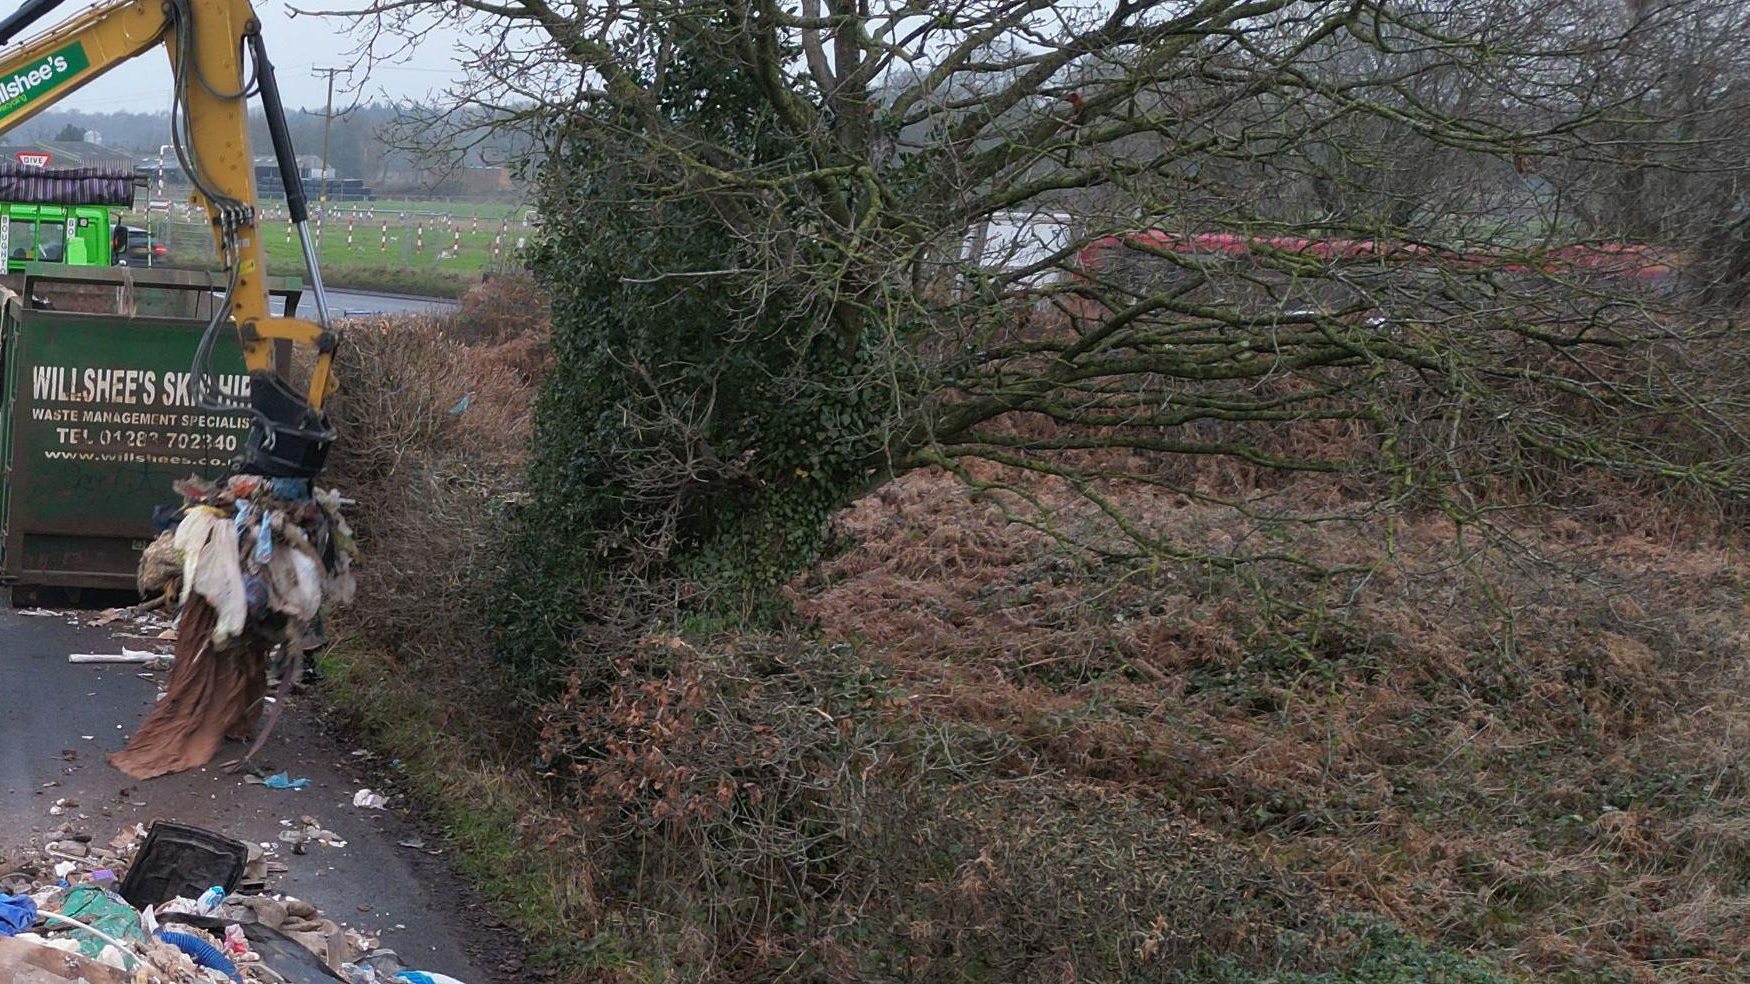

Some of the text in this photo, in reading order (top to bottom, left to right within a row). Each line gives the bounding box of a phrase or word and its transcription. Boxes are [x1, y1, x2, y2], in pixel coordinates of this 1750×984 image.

[0, 216, 8, 274] BOUGHTO
[33, 365, 156, 405] WILLSHEE'S
[32, 408, 251, 429] WASTE MANAGEMENT SPECIALIS
[56, 428, 94, 445] TEL
